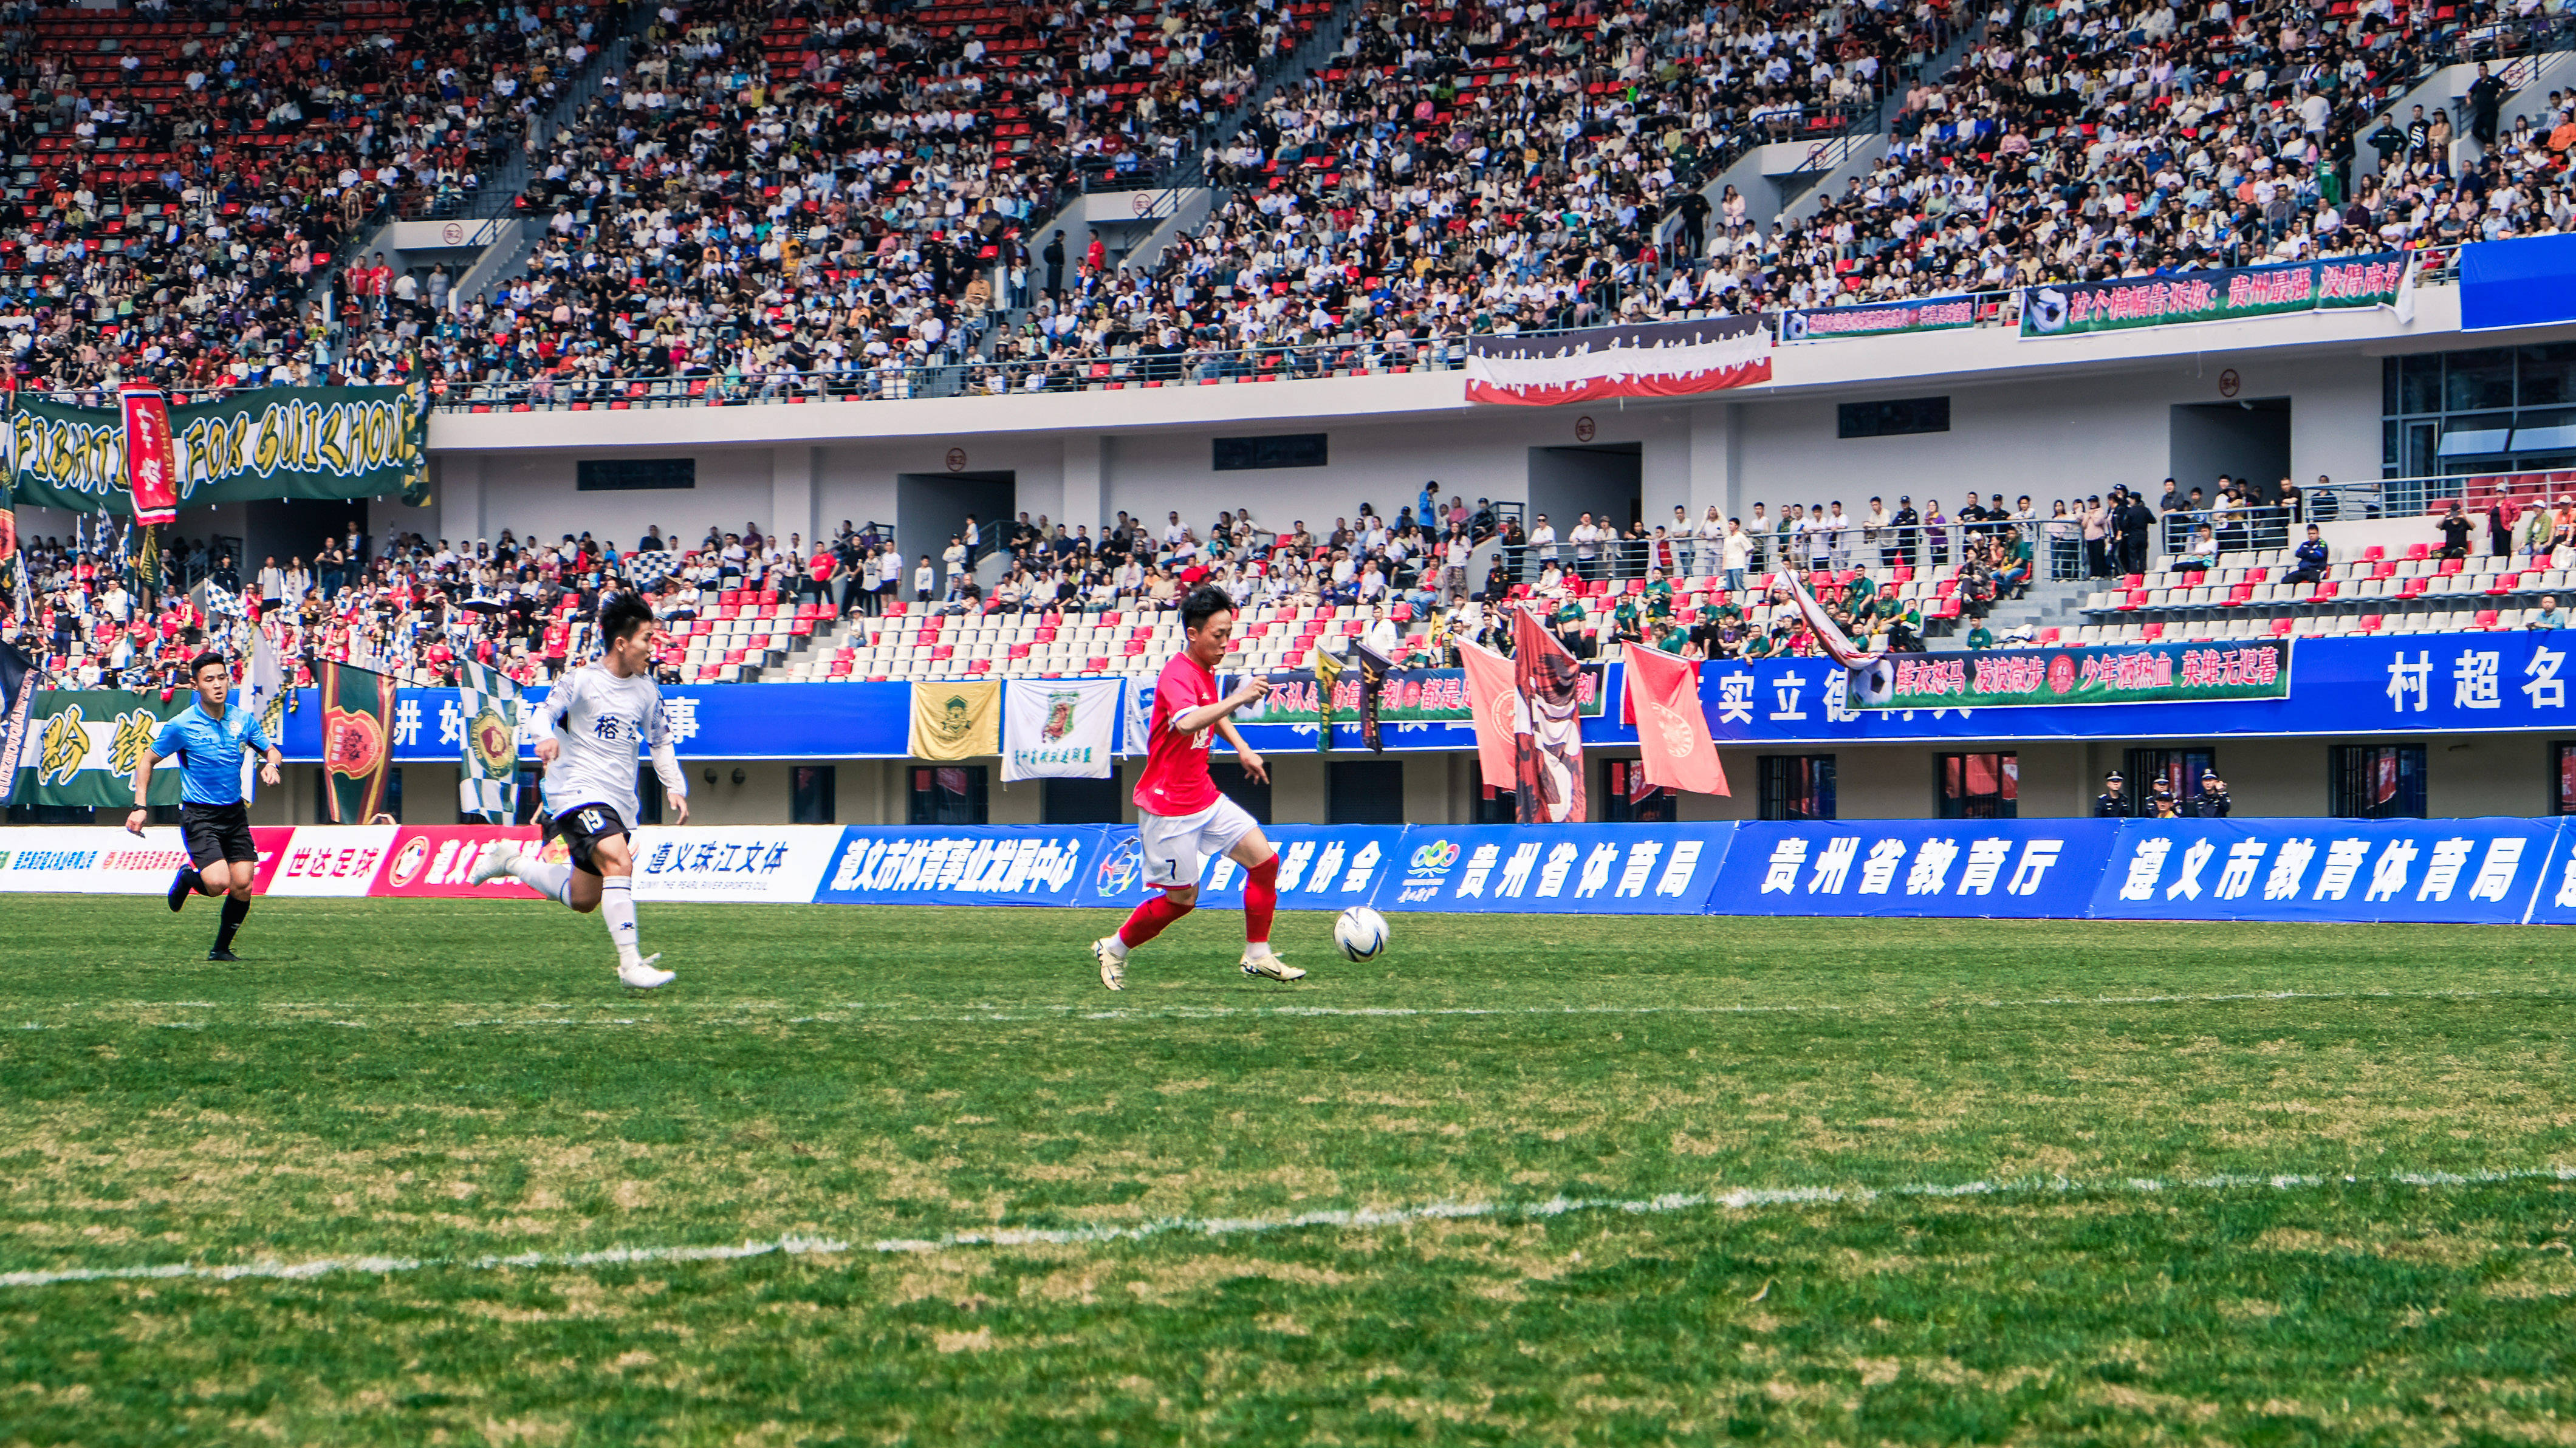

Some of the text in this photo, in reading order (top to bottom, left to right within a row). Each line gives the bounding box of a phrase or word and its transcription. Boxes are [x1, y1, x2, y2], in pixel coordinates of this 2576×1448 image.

[2385, 645, 2566, 712] 村超名
[578, 808, 604, 833] 19
[287, 847, 380, 878] 世达足球
[644, 841, 789, 874] 遵义珠江文体
[831, 837, 1080, 893] 遵义市体育事业发展中心
[1165, 859, 1177, 880] 7
[1456, 841, 1704, 898] 贵州省体育局
[1761, 837, 2064, 895] 贵州省教育厅
[2119, 836, 2527, 902] 遵义市教育体育局
